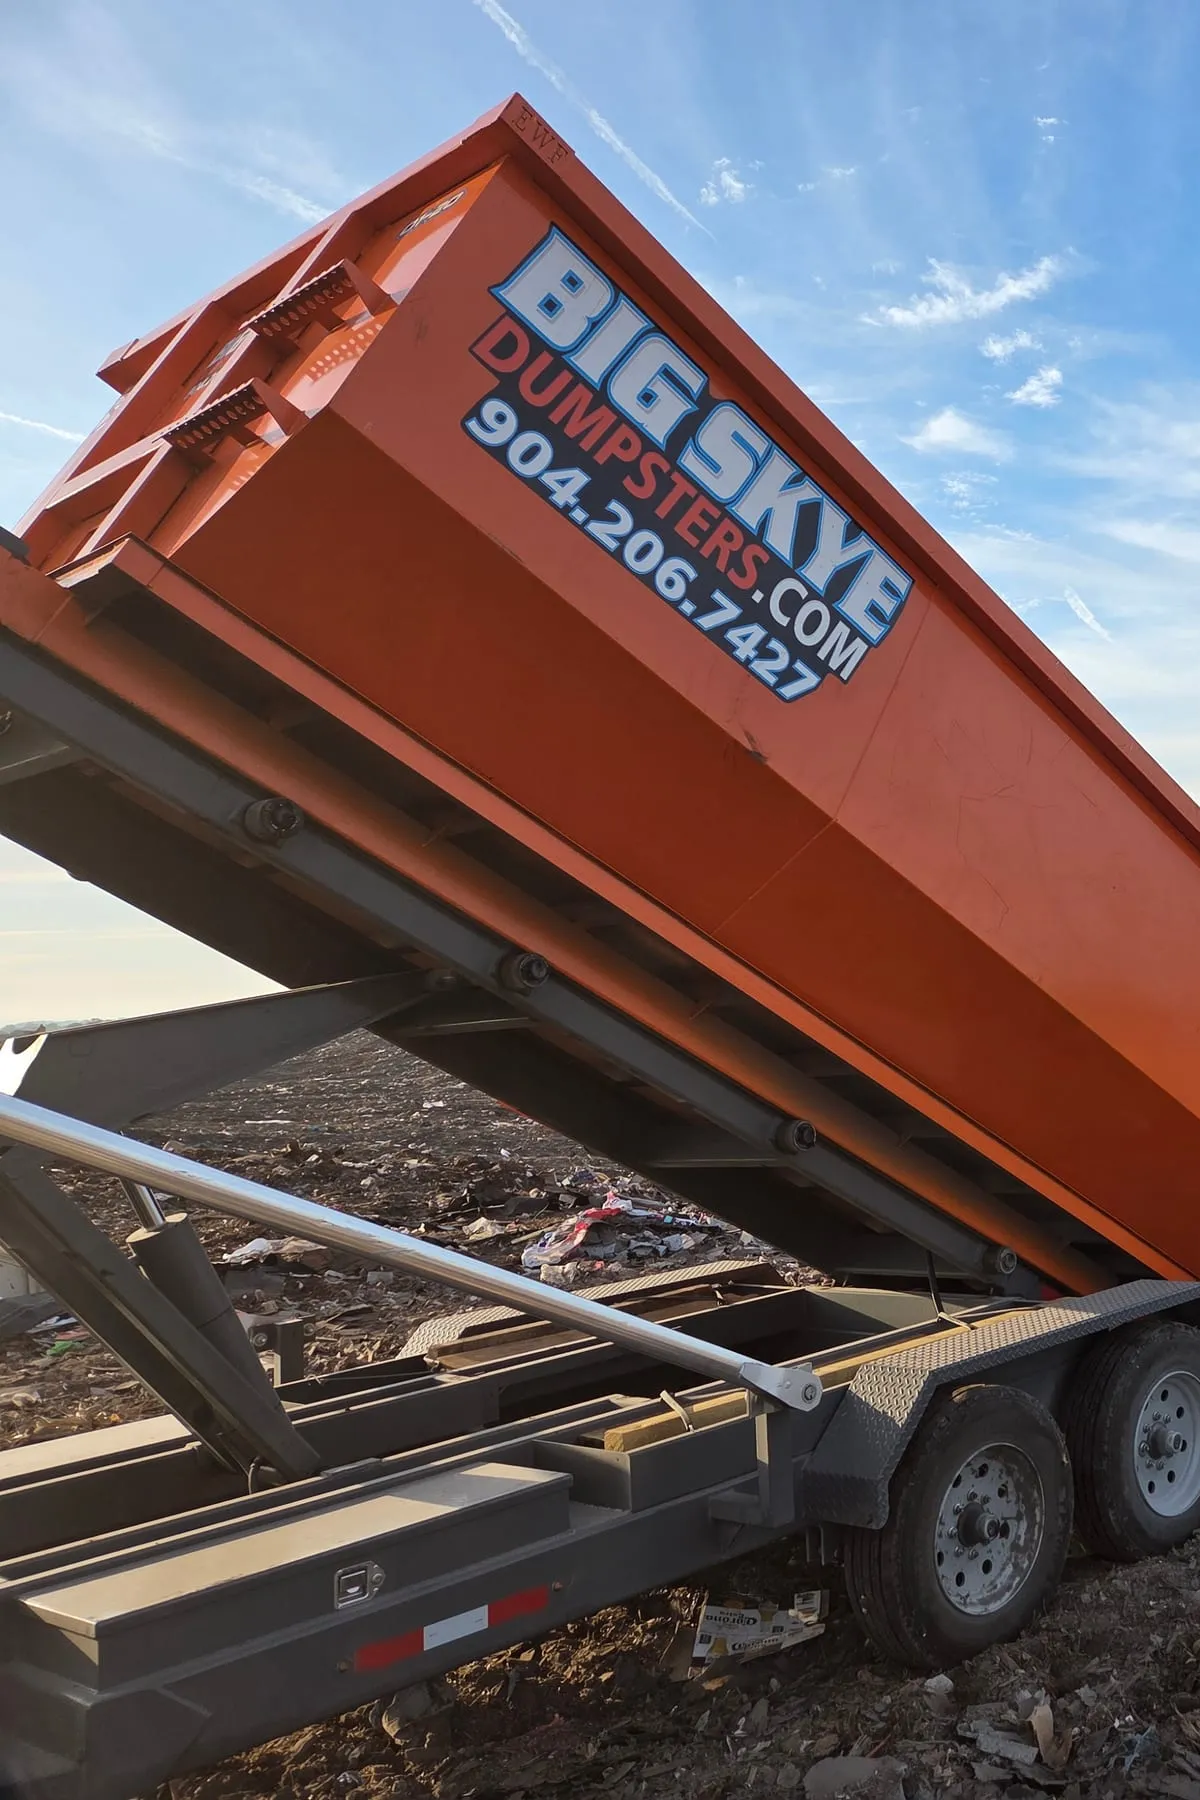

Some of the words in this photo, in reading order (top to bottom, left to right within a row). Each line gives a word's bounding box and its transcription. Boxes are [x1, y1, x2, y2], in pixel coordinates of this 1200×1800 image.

[465, 398, 821, 700] 904.206.7427
[472, 315, 869, 681] DUMPSTERS.COM
[488, 226, 709, 451] BIG
[677, 402, 915, 648] SKYE
[705, 1615, 758, 1626] Corona
